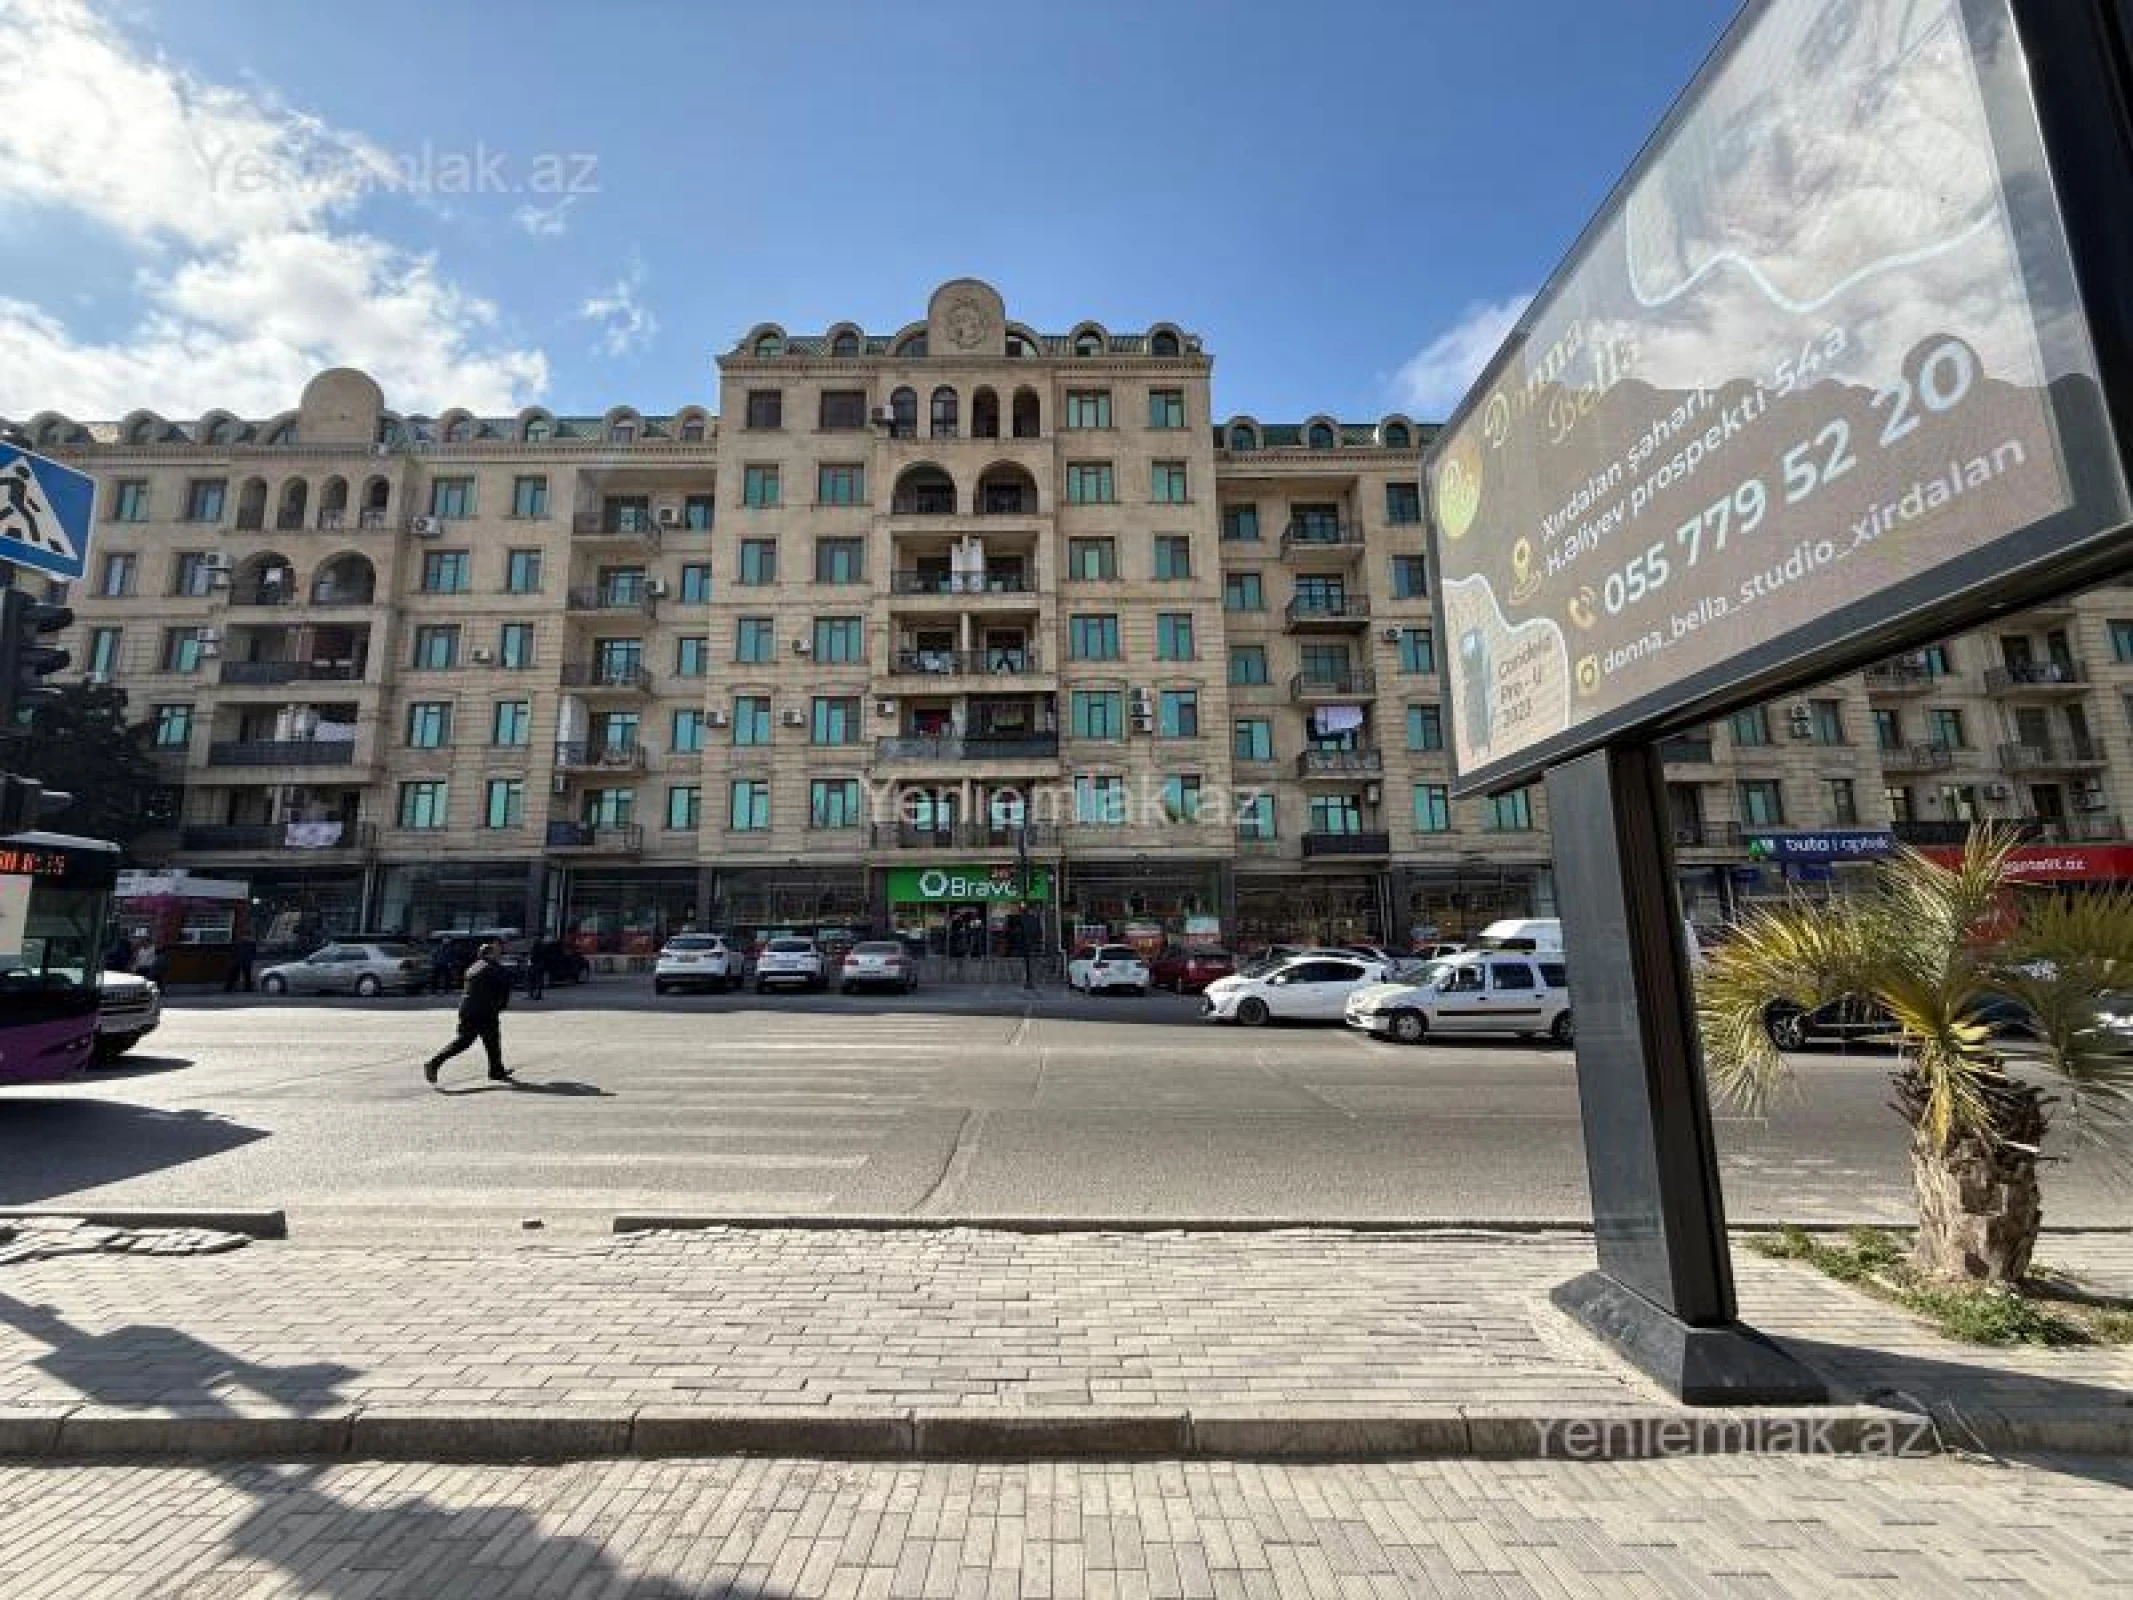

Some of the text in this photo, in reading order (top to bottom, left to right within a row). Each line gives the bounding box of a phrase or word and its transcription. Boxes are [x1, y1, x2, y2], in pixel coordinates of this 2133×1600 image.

[1603, 340, 1974, 615] 055 779 52 20
[1631, 378, 1766, 518] prospekti
[1774, 326, 1846, 398] 54a
[1603, 438, 2026, 676] donna_bella_studio_xirdalan
